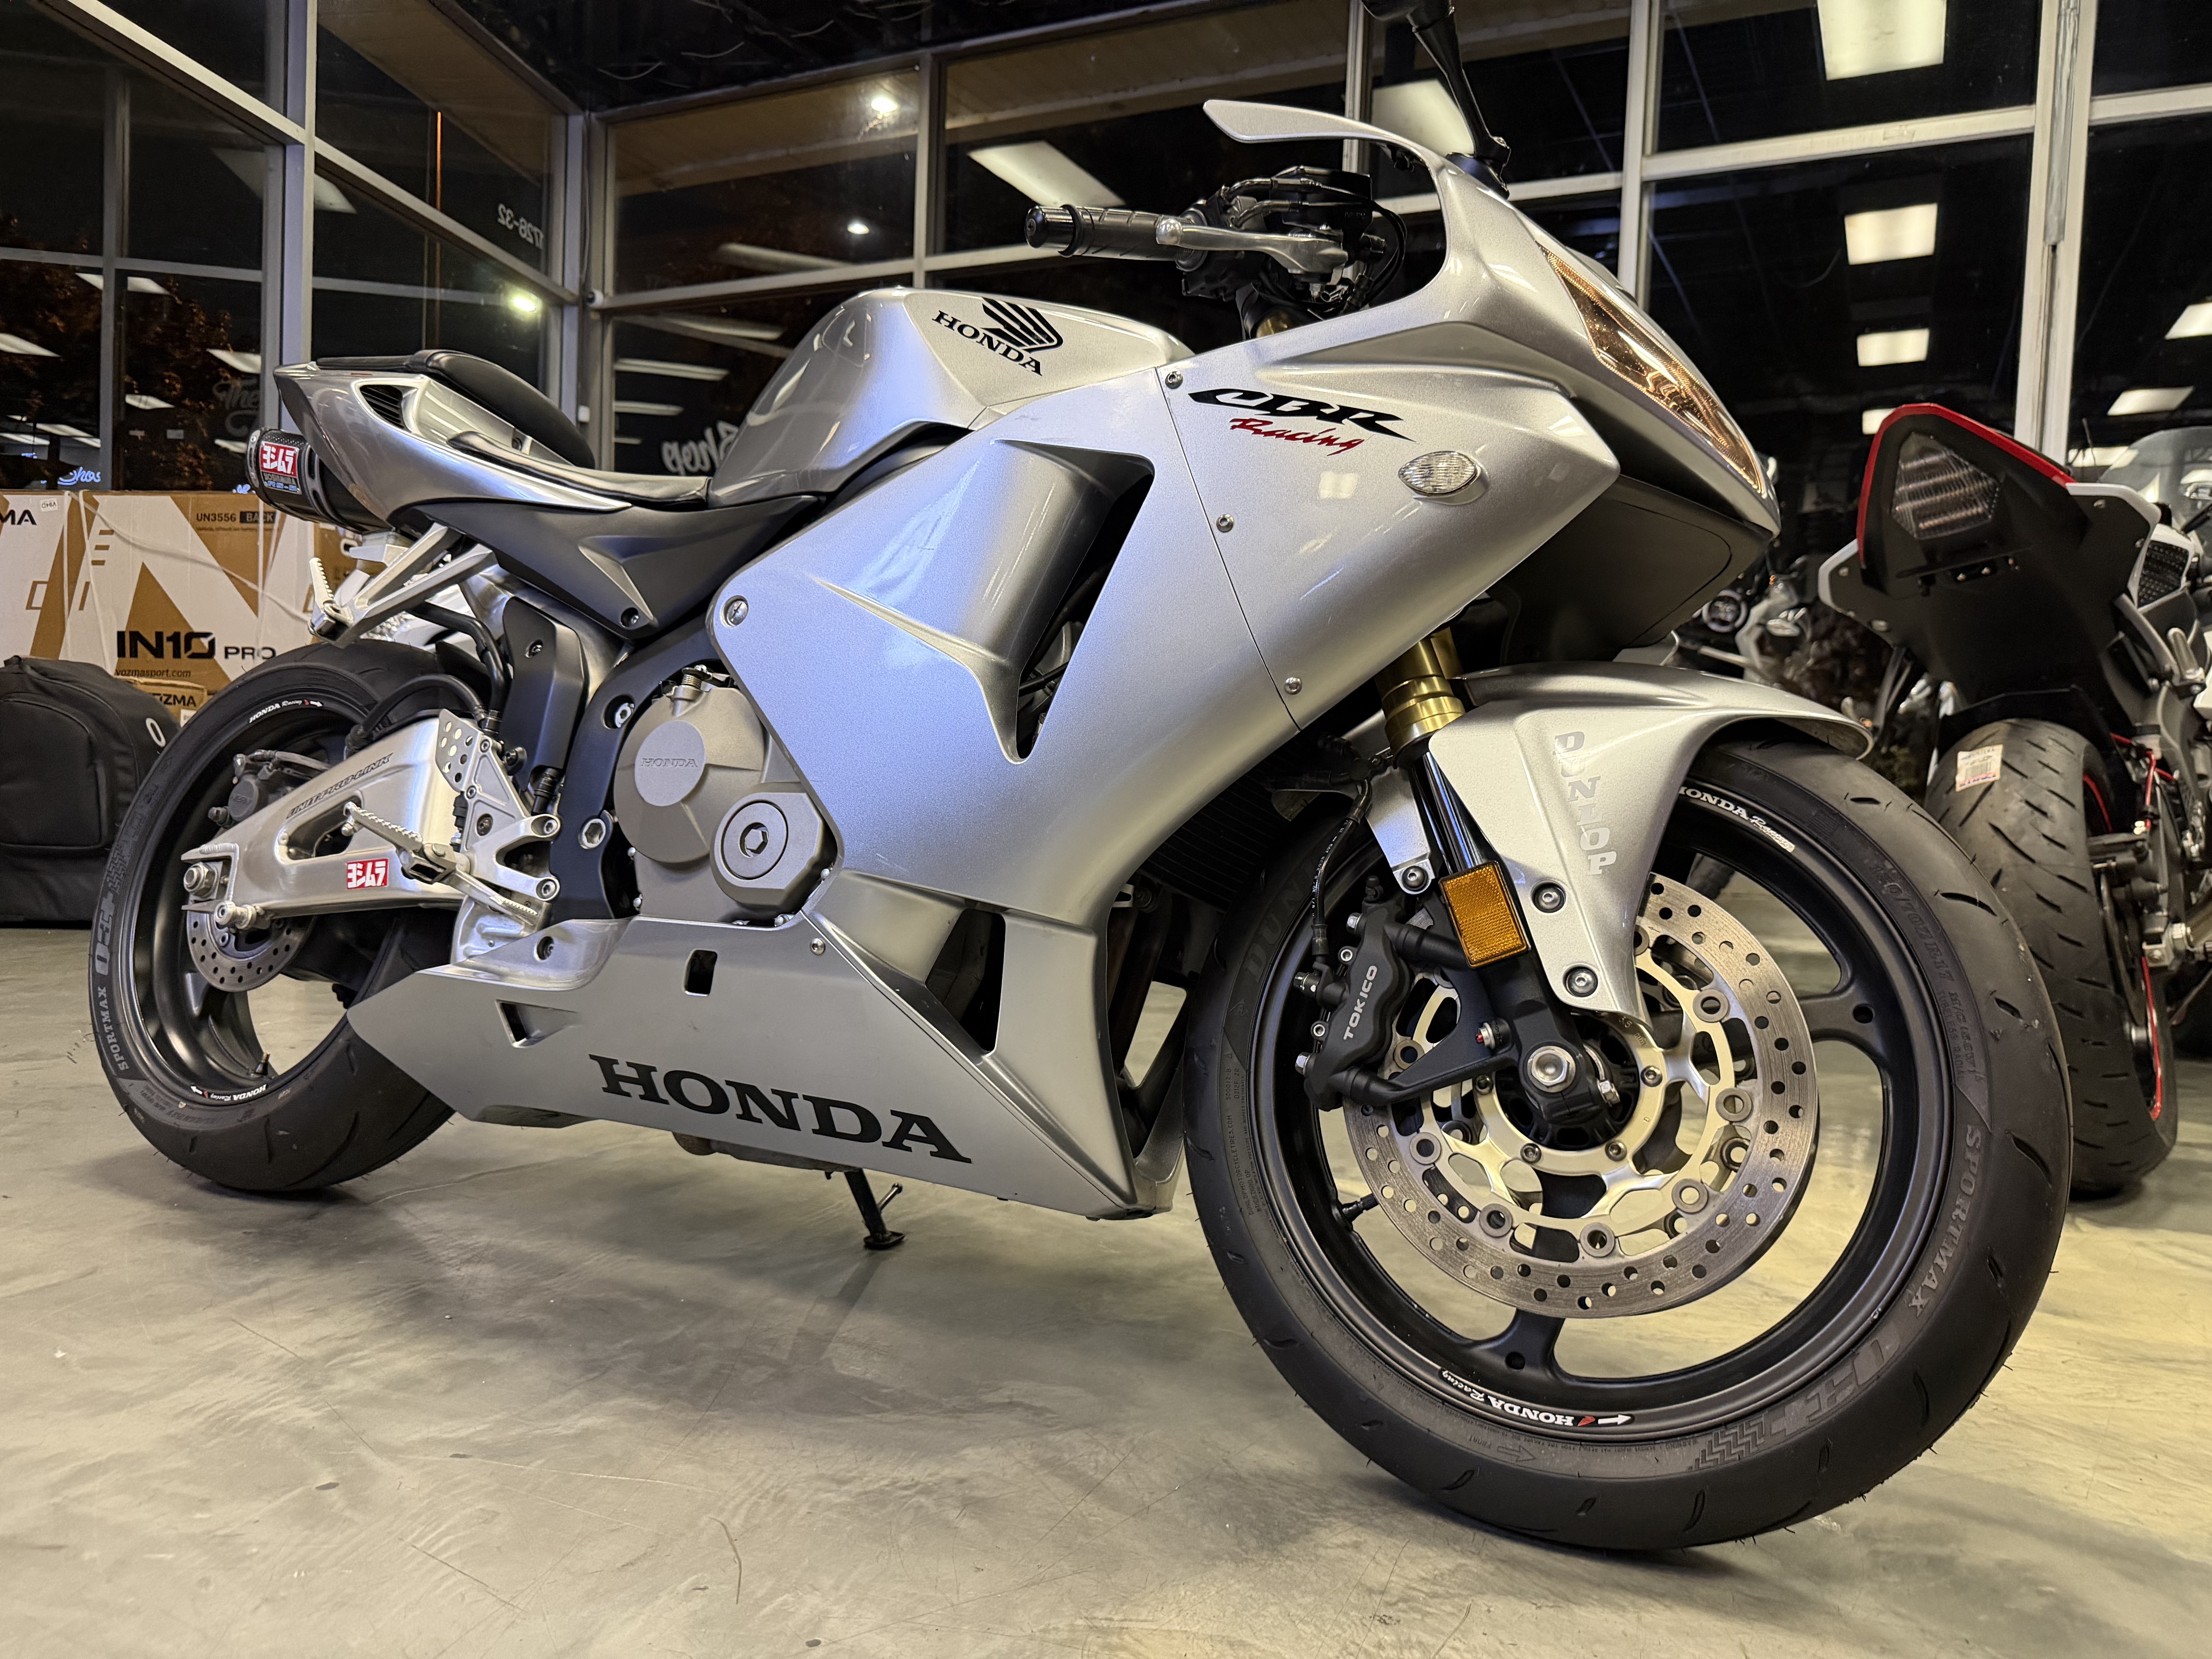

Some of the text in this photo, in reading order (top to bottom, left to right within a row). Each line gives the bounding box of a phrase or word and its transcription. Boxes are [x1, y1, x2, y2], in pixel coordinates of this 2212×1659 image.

[931, 309, 1042, 376] HONDA
[1187, 388, 1416, 442] CBR
[1229, 417, 1365, 457] Racing
[197, 513, 236, 522] UN3556
[224, 646, 276, 659] PRO
[249, 703, 281, 723] HONDA
[639, 757, 697, 768] HONDA
[1553, 731, 1616, 876] DUNLOP
[1750, 816, 1795, 853] Racing
[348, 861, 386, 887] ヨシムラ
[1343, 965, 1377, 1041] TOKICO
[97, 985, 129, 1071] SPORTMAX
[1950, 1046, 1966, 1081] RADIAL
[233, 1084, 266, 1101] HONDA
[589, 1054, 972, 1164] HONDA
[1908, 1124, 1982, 1317] SPORTMAX
[1441, 1369, 1573, 1426] HONDA Racing
[1468, 1434, 1492, 1449] FRONT
